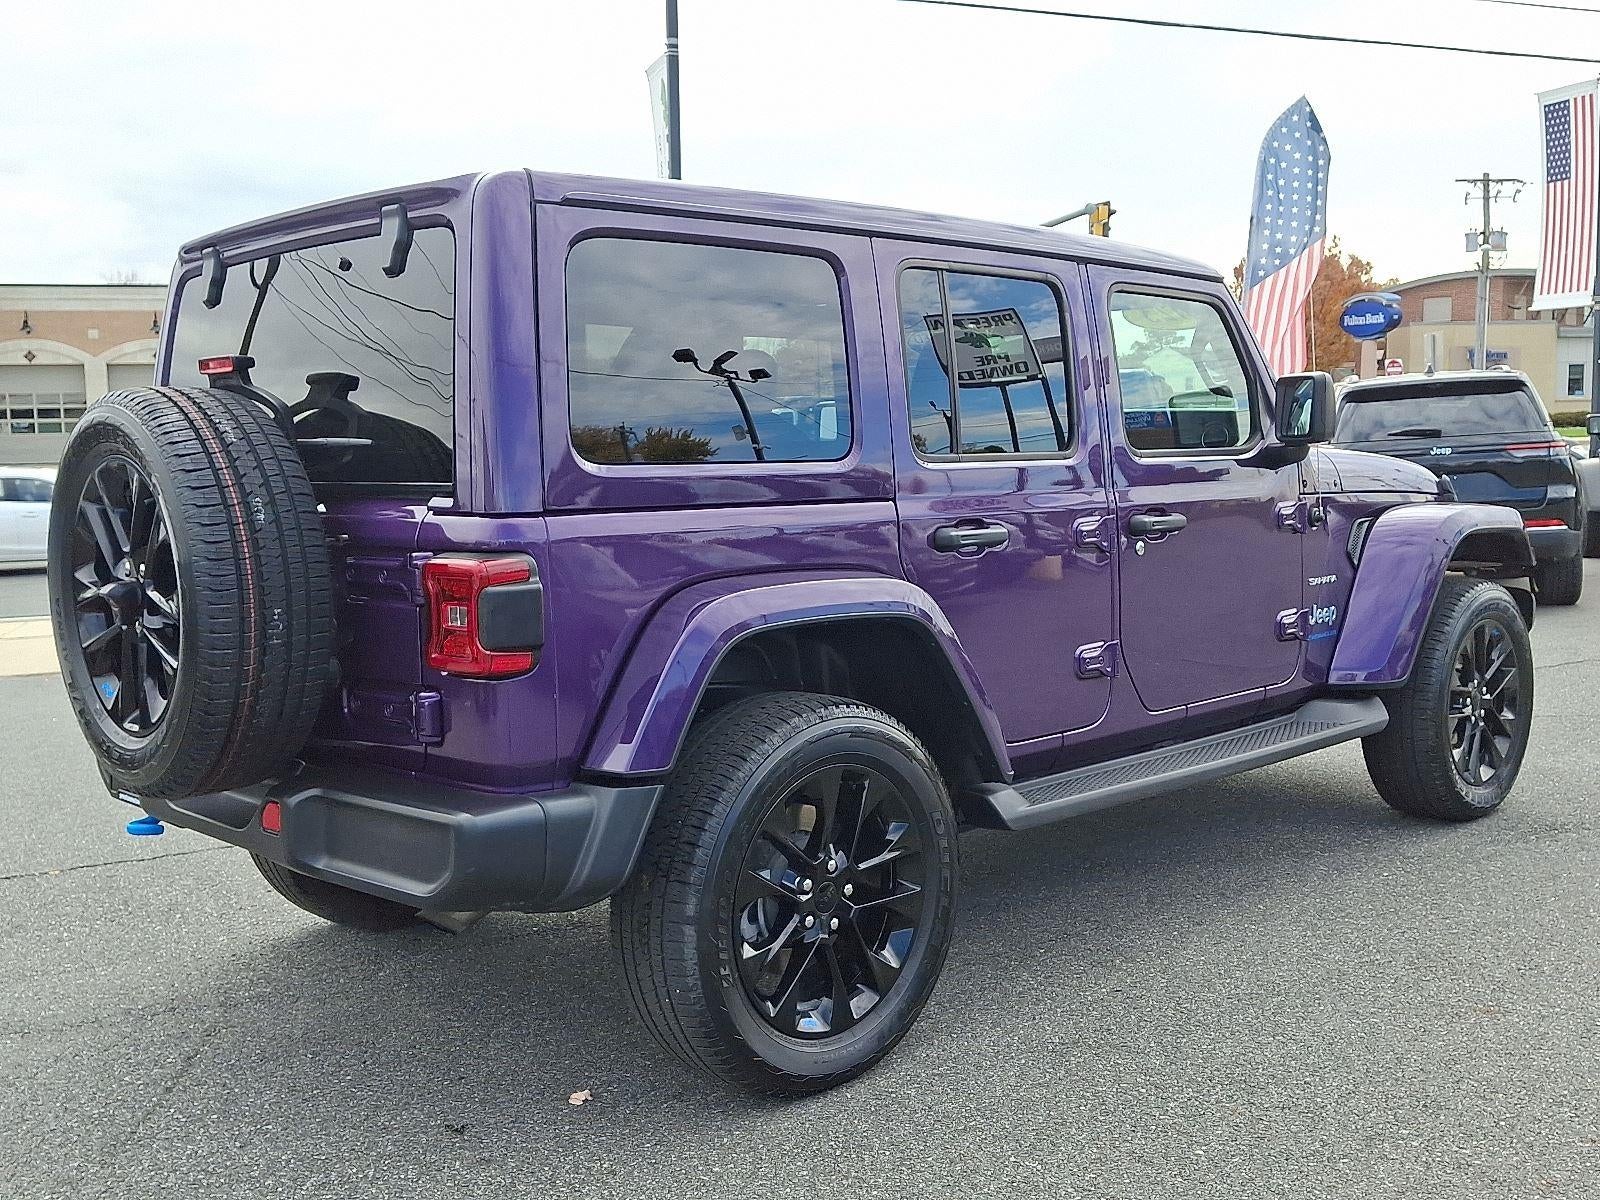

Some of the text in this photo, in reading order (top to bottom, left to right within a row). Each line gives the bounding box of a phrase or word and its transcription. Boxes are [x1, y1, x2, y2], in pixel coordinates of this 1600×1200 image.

[1343, 314, 1366, 327] Fulton
[1365, 311, 1385, 325] Bank
[1430, 446, 1452, 456] Jeep
[1308, 603, 1337, 626] Jeep
